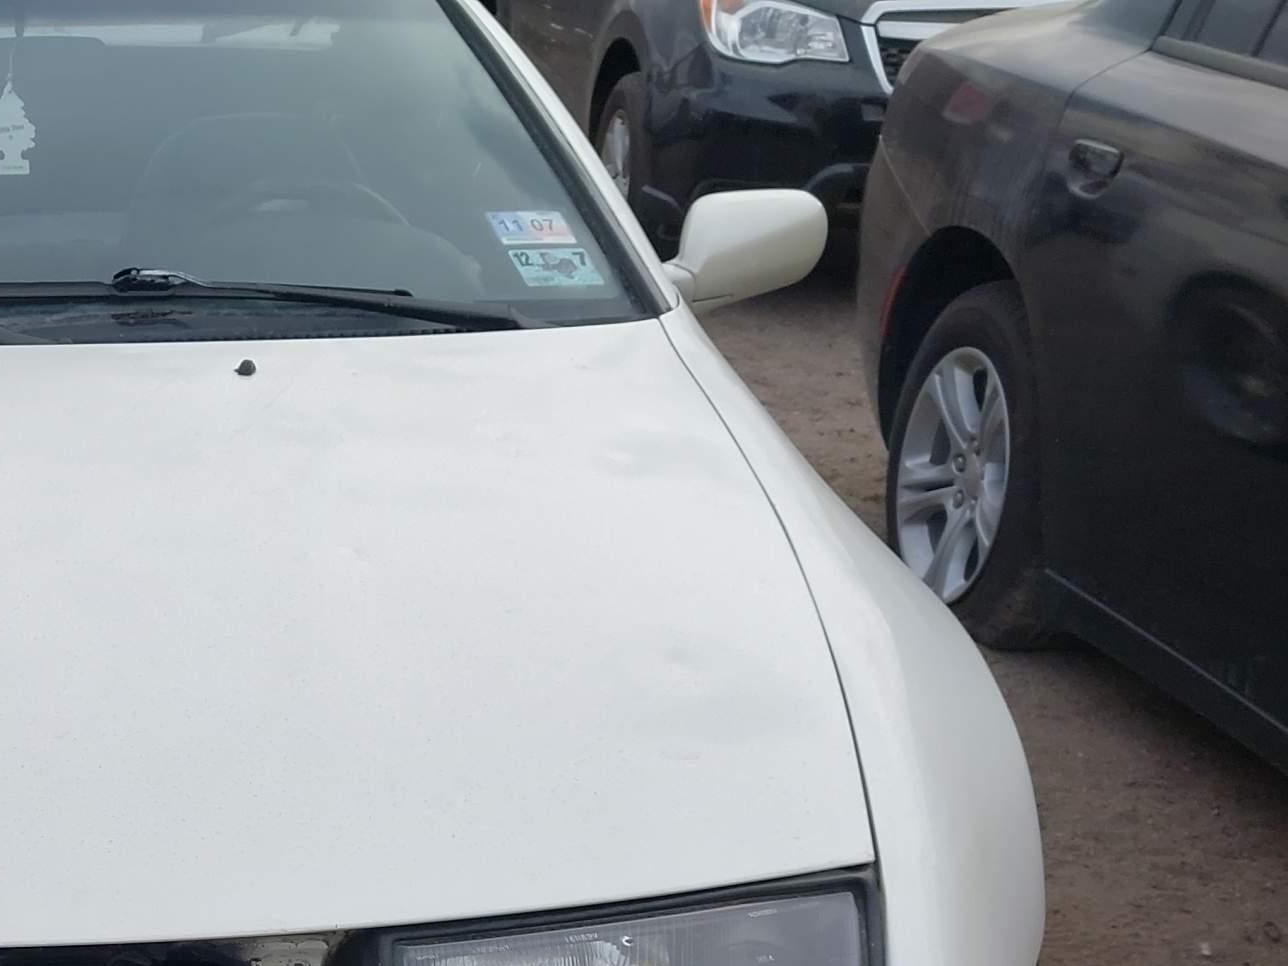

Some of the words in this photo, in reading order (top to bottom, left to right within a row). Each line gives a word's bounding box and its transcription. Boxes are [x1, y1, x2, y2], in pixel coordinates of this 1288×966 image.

[498, 219, 524, 232] 11
[530, 218, 554, 232] 07
[513, 251, 534, 267] 12
